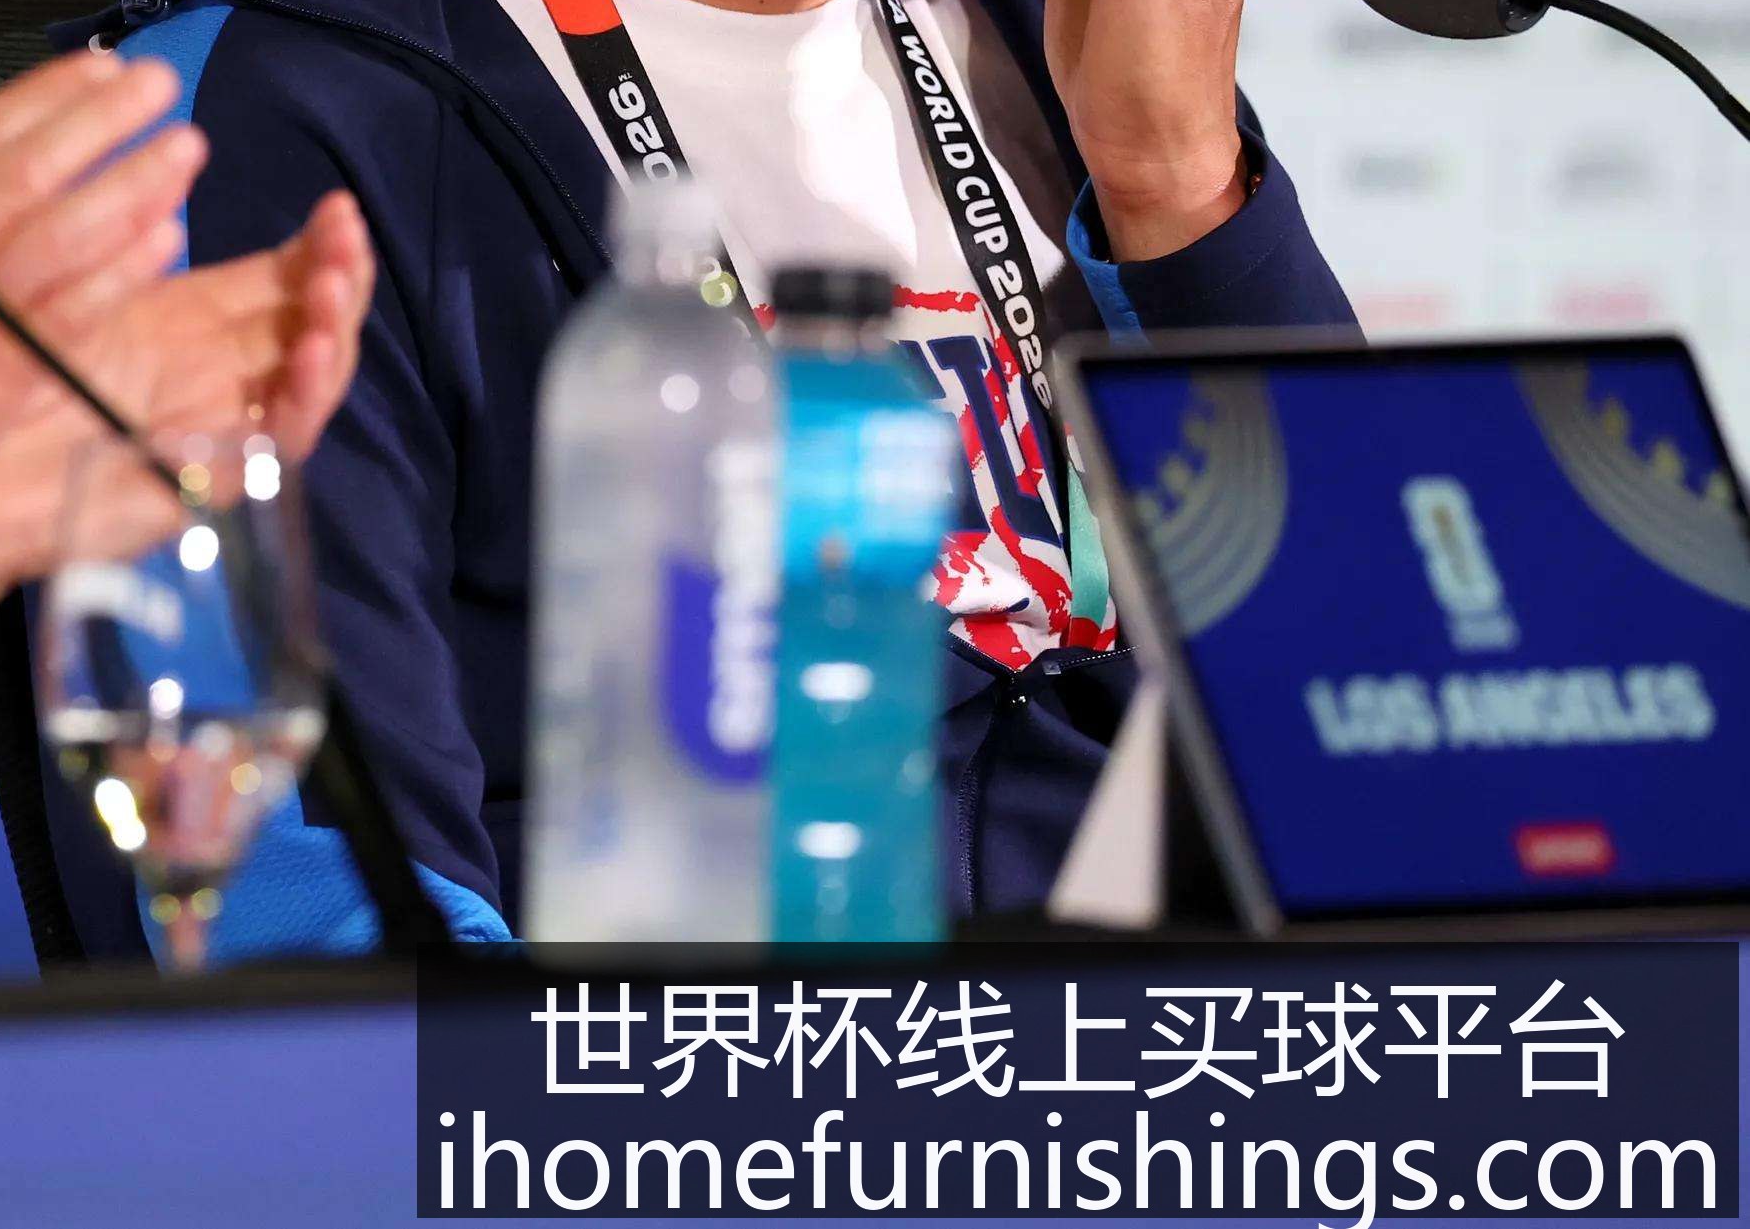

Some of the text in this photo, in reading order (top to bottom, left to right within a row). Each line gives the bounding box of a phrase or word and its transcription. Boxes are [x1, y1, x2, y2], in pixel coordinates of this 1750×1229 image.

[900, 34, 977, 170] WORLD
[955, 175, 1010, 255] CUP
[985, 258, 1053, 411] 2026
[1305, 664, 1717, 755] LOS ANGELES
